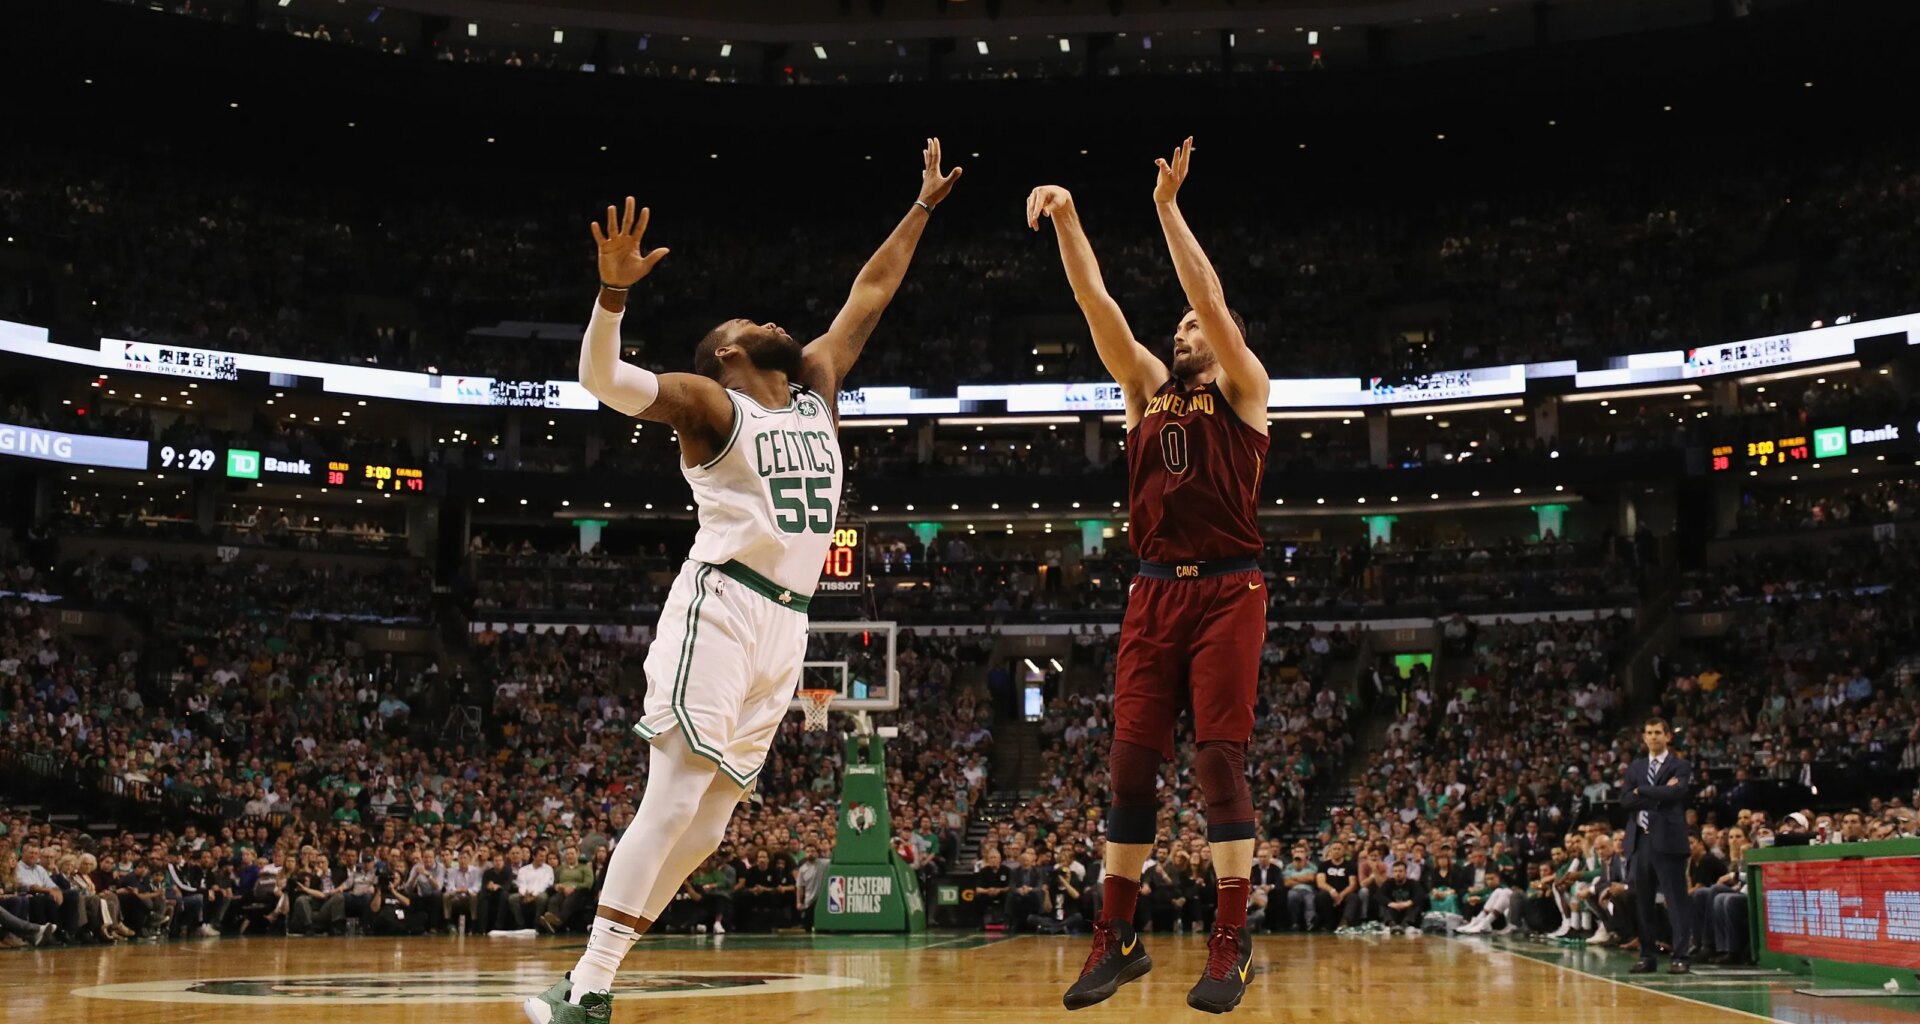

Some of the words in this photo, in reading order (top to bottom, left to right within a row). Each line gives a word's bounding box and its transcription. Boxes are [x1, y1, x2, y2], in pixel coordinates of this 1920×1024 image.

[1144, 393, 1214, 417] CLEVELAND
[1818, 431, 1843, 452] TD
[1850, 423, 1900, 445] Bank
[755, 429, 835, 477] CELTICS
[1160, 422, 1188, 474] 0
[1790, 446, 1808, 459] 47
[160, 446, 216, 471] 9:29
[231, 453, 257, 473] TD
[264, 457, 311, 474] Bank
[328, 471, 345, 485] 38
[365, 464, 392, 479] 3:00
[407, 479, 423, 491] 47
[769, 477, 832, 533] 55
[1176, 565, 1199, 578] CAVS
[820, 582, 860, 590] TISSOT
[847, 876, 891, 895] EASTERN
[847, 895, 881, 913] FINALS
